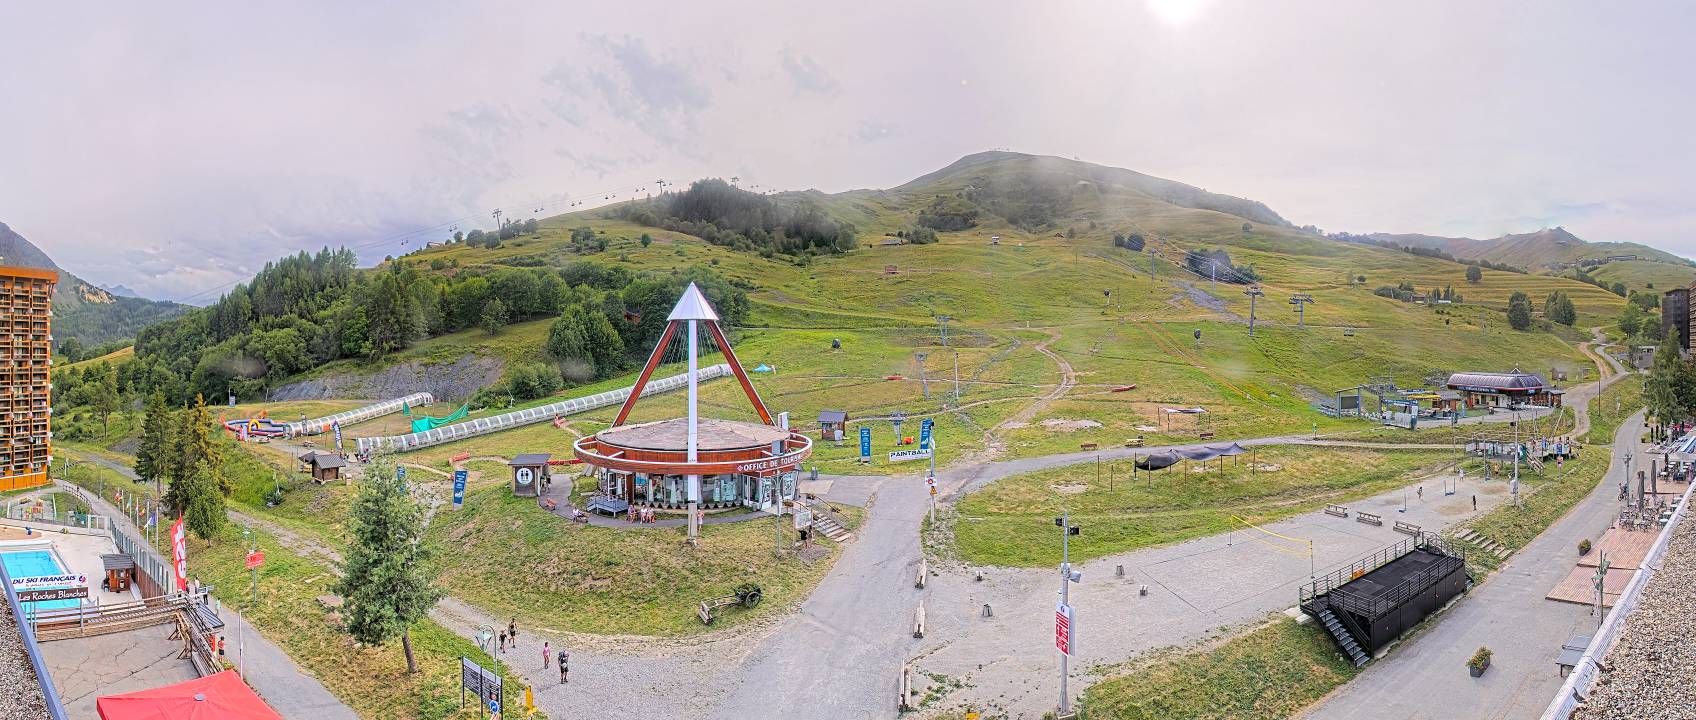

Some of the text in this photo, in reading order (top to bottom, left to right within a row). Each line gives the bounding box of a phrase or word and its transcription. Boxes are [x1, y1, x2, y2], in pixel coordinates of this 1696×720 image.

[890, 450, 928, 458] PAINTBALL
[744, 462, 767, 472] OFFICE
[19, 590, 86, 602] Les Roches Blanches
